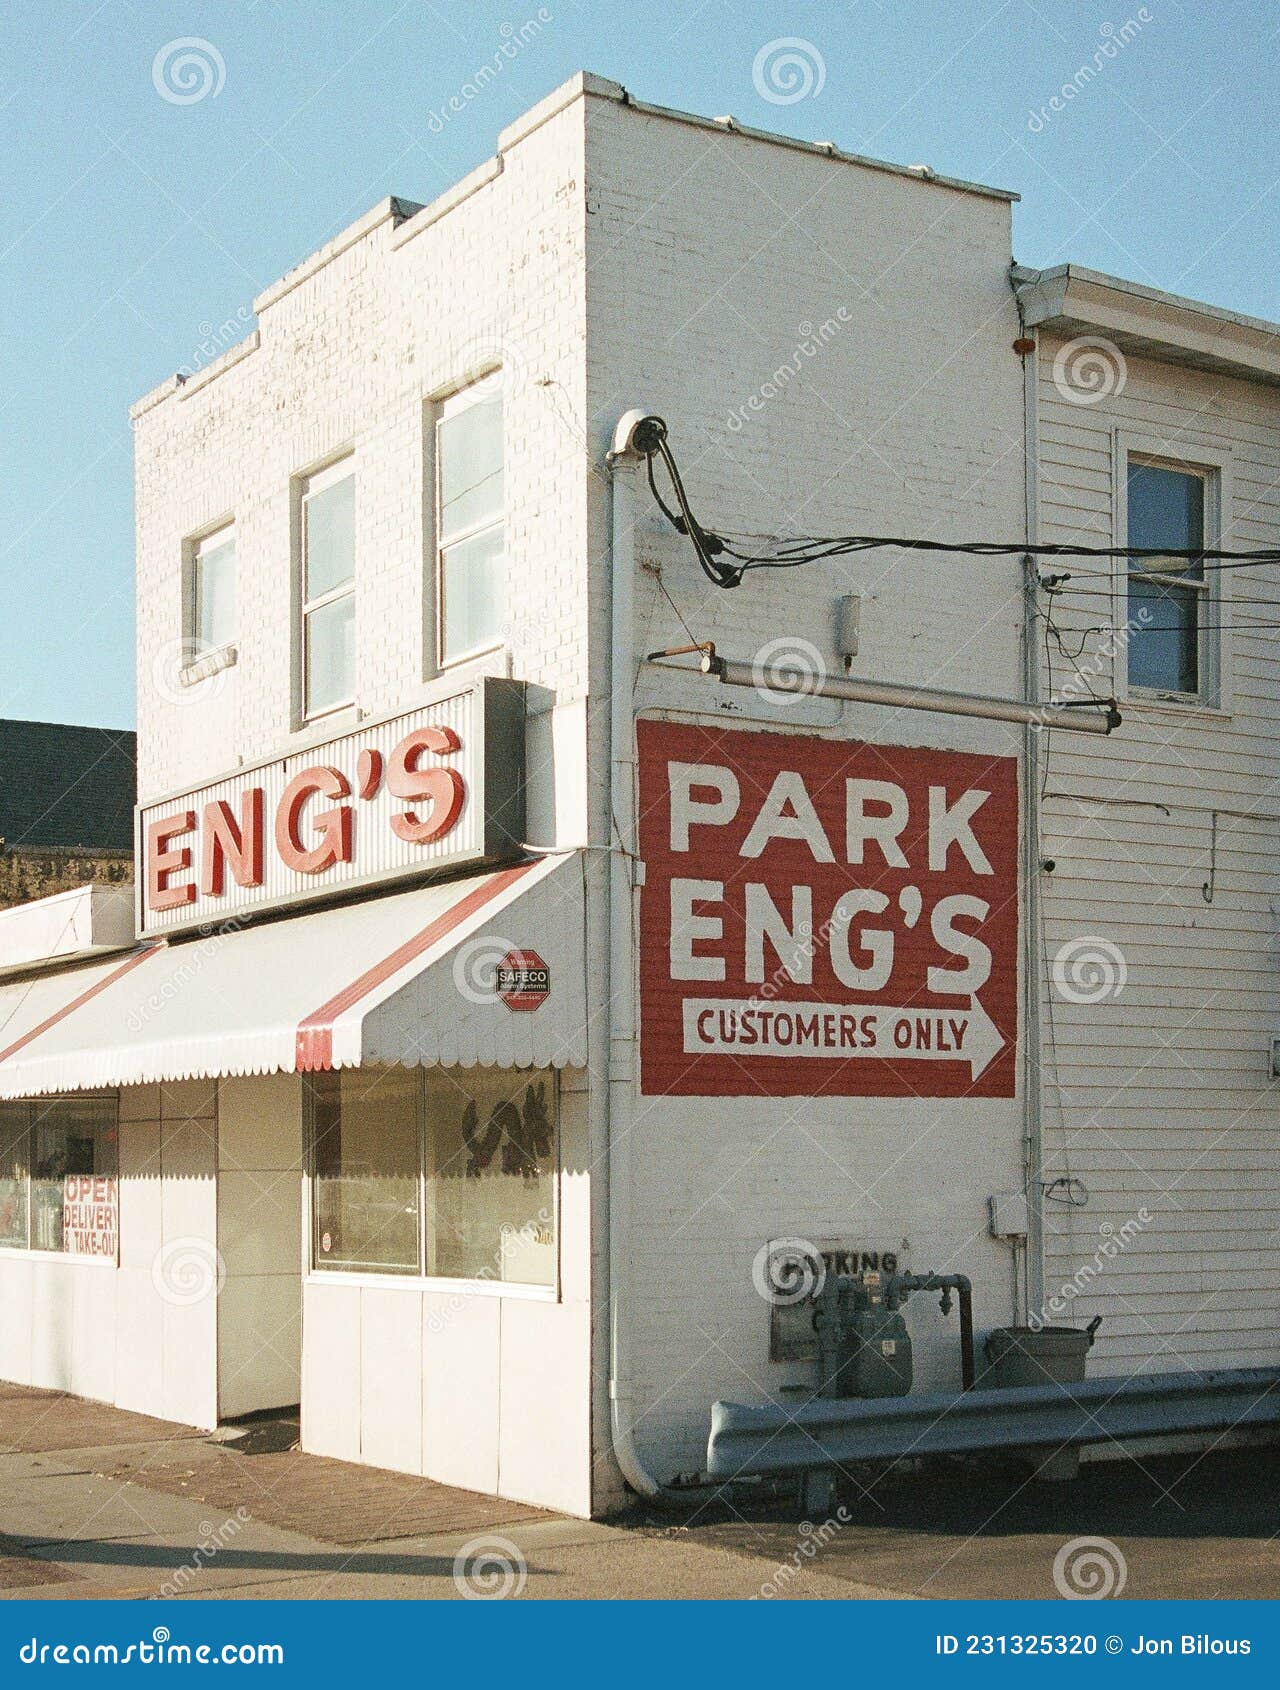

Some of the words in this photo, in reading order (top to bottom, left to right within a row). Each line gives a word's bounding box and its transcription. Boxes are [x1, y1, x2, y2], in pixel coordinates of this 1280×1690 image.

[148, 725, 466, 912] ENG'S
[667, 760, 996, 876] PARK
[669, 877, 993, 995] ENG'S
[499, 971, 547, 982] SAFECO
[697, 1008, 877, 1048] CUSTOMERS
[894, 1018, 969, 1051] ONLY
[74, 1231, 117, 1256] TAKE-OU
